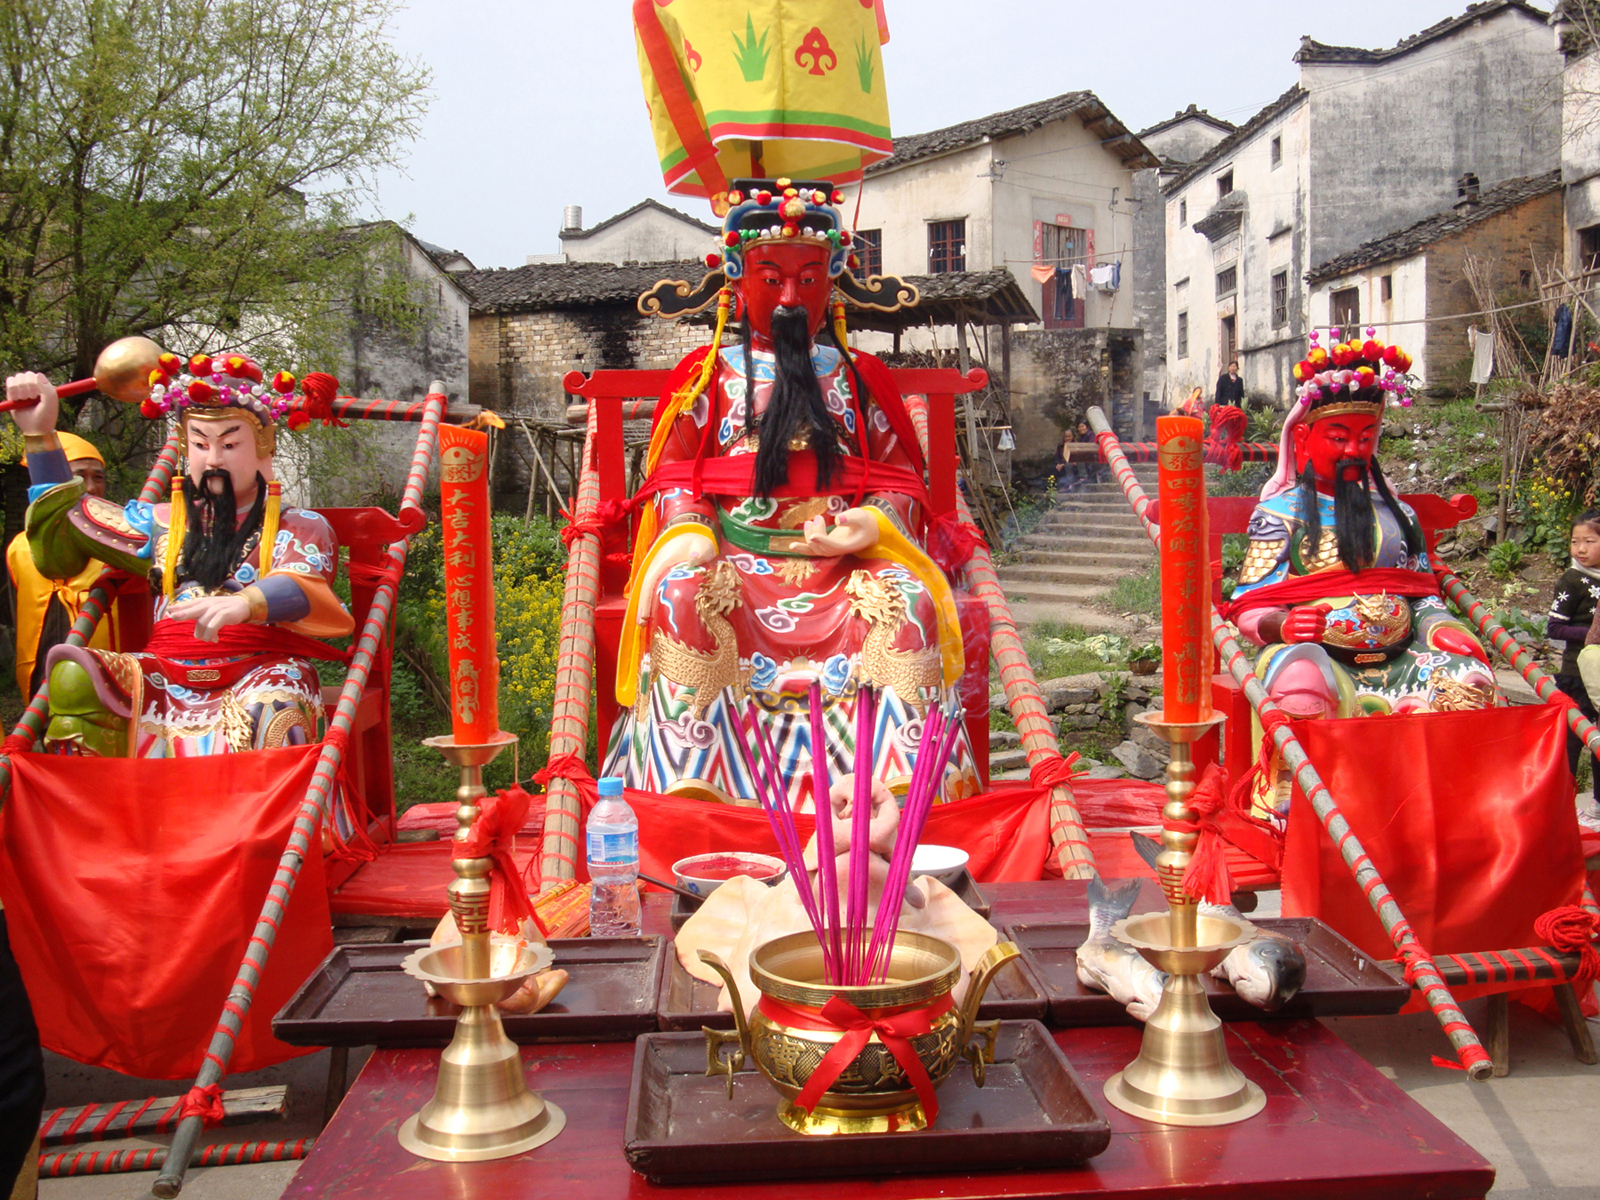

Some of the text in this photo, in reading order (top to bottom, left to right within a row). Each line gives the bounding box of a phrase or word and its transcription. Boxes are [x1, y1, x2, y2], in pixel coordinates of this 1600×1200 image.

[445, 489, 476, 653] 大吉大利心想事成
